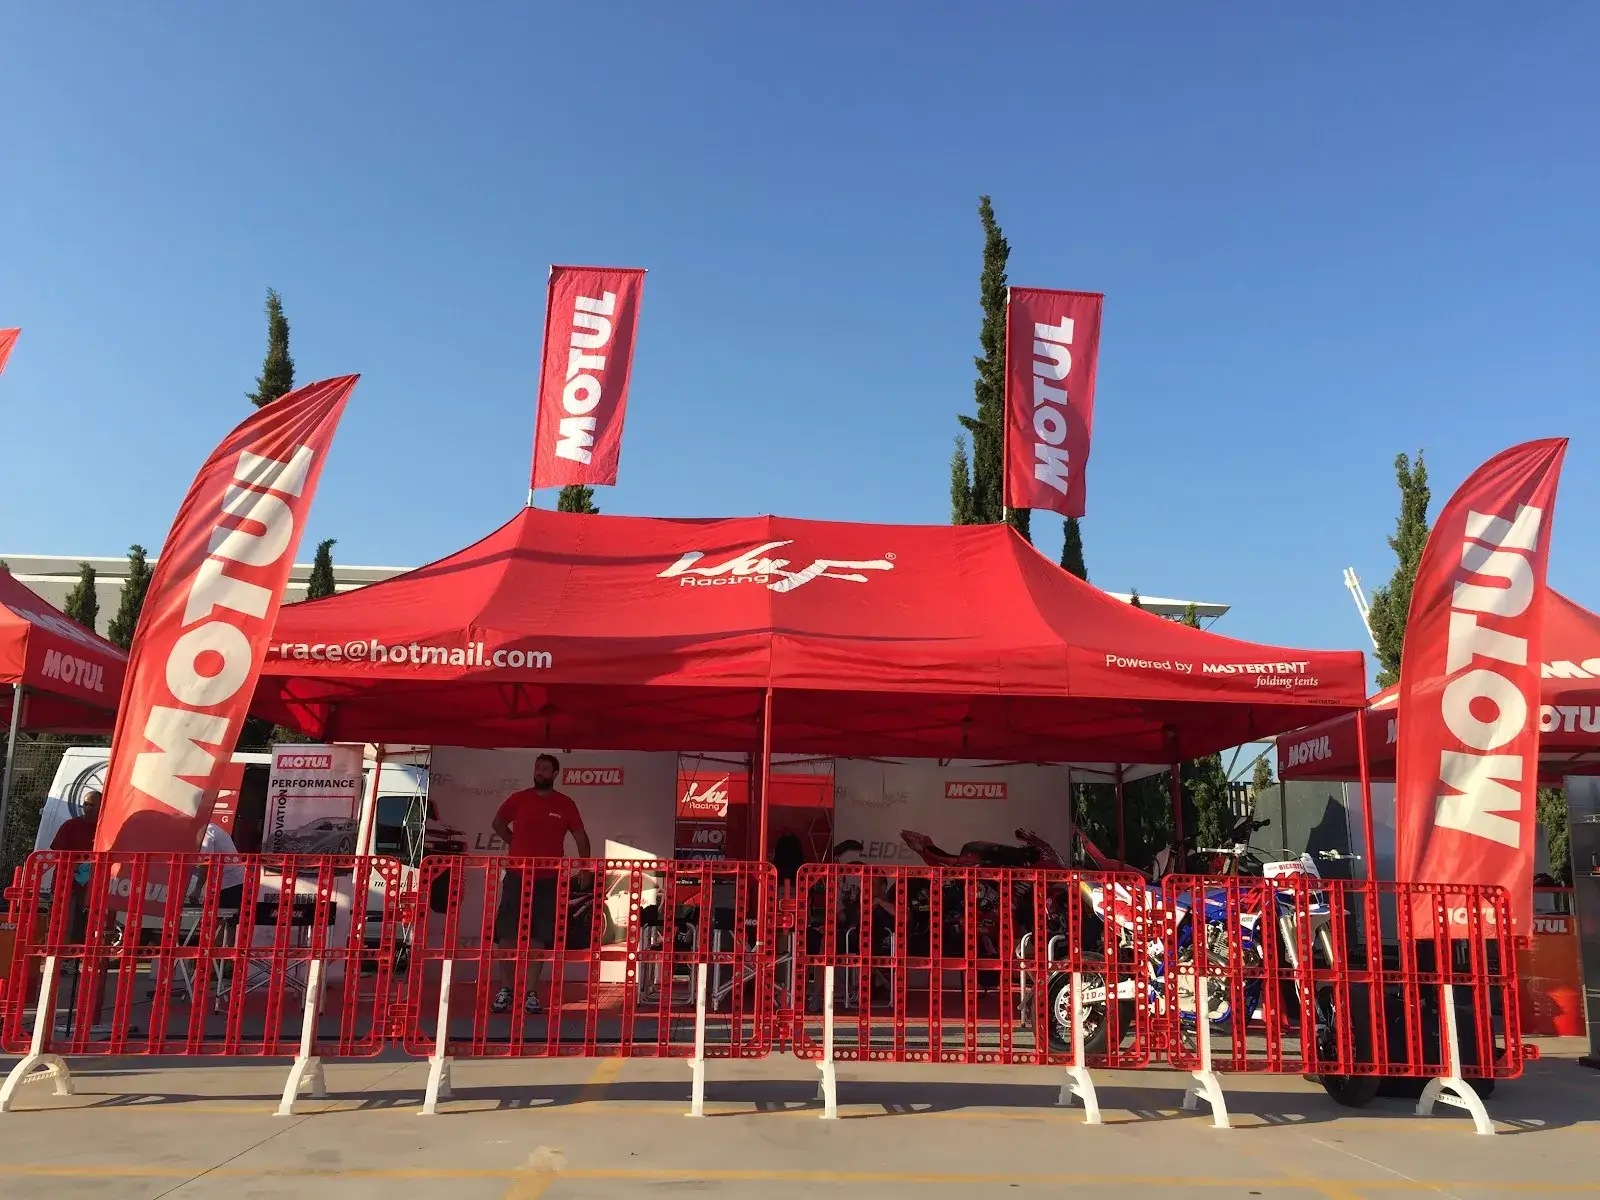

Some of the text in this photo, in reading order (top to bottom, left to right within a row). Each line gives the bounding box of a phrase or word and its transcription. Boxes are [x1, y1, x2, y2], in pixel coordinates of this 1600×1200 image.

[555, 291, 616, 465] MOTUL
[1032, 316, 1075, 496] MOTUL
[680, 574, 769, 587] Racing
[129, 444, 315, 818] MOTUL
[41, 648, 104, 692] MOTUL
[1105, 654, 1308, 675] Powered by MASTERTENT
[1255, 675, 1319, 689] folding tents
[1434, 502, 1542, 849] MOTUL
[1287, 735, 1332, 768] MOTUL
[279, 756, 329, 768] MOTUL
[271, 779, 355, 788] PERFORMANCE
[565, 770, 621, 784] MOTUL
[947, 783, 1004, 797] MOTUL
[689, 802, 720, 812] Racing
[1532, 918, 1568, 933] TUL
